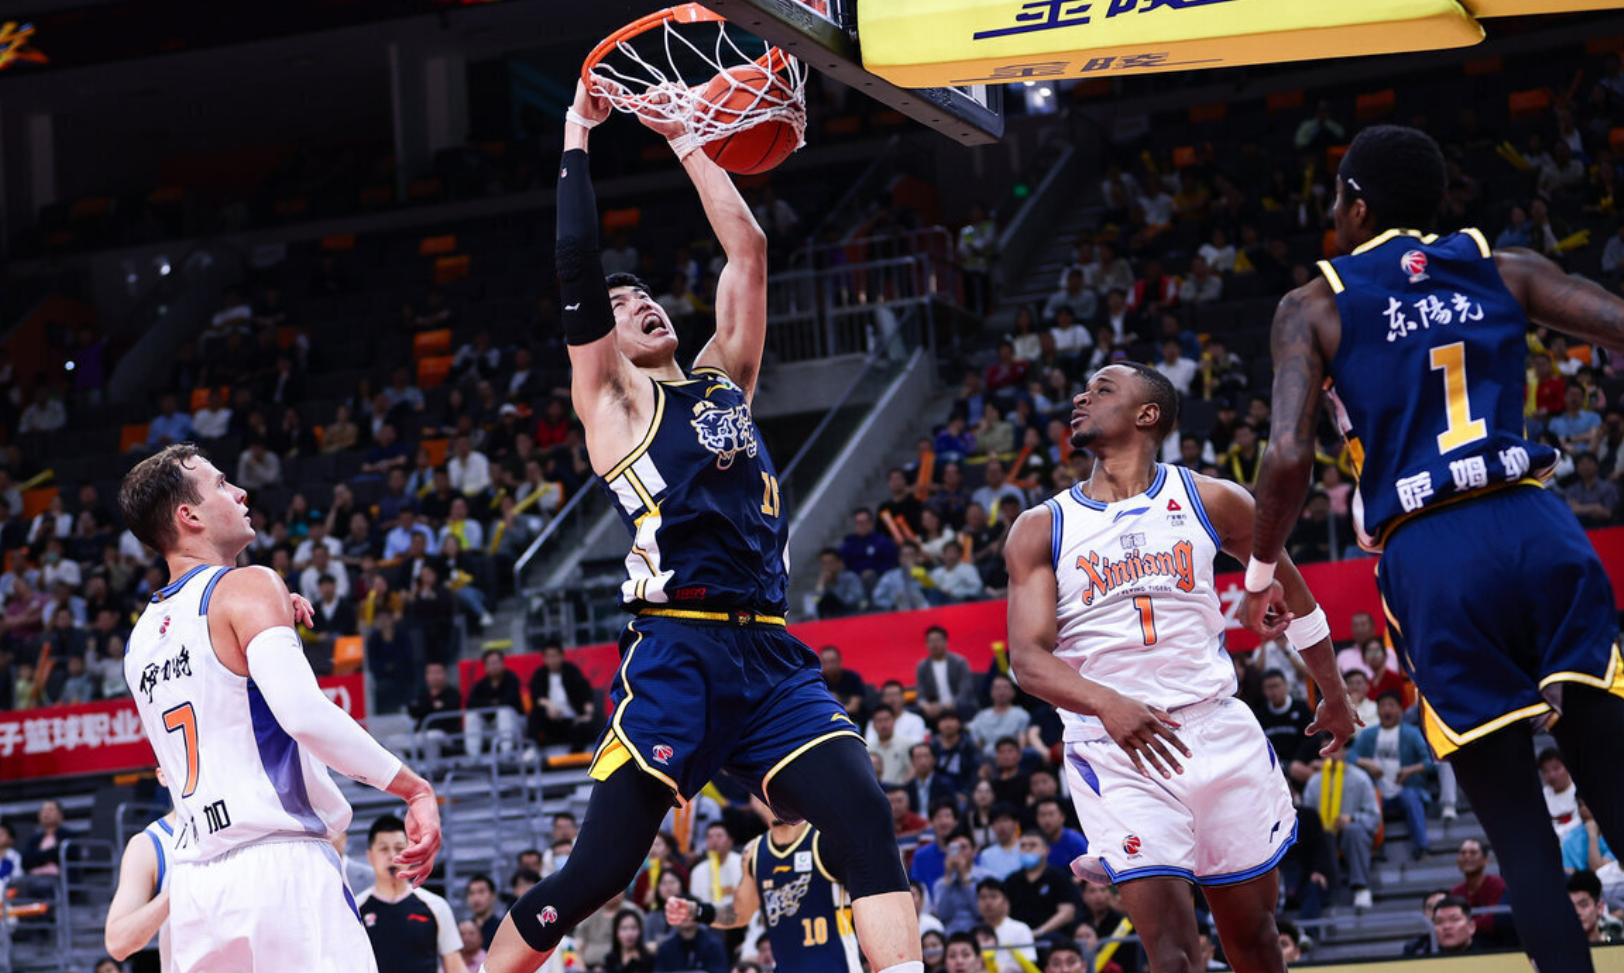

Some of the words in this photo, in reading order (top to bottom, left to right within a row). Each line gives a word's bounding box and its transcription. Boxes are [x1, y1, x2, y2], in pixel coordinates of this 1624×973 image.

[1429, 341, 1488, 455] 1
[1076, 540, 1195, 605] Xinjiang
[1133, 594, 1157, 646] 1
[0, 708, 149, 757] 子篮球职业
[162, 700, 199, 799] 7
[801, 916, 828, 948] 10
